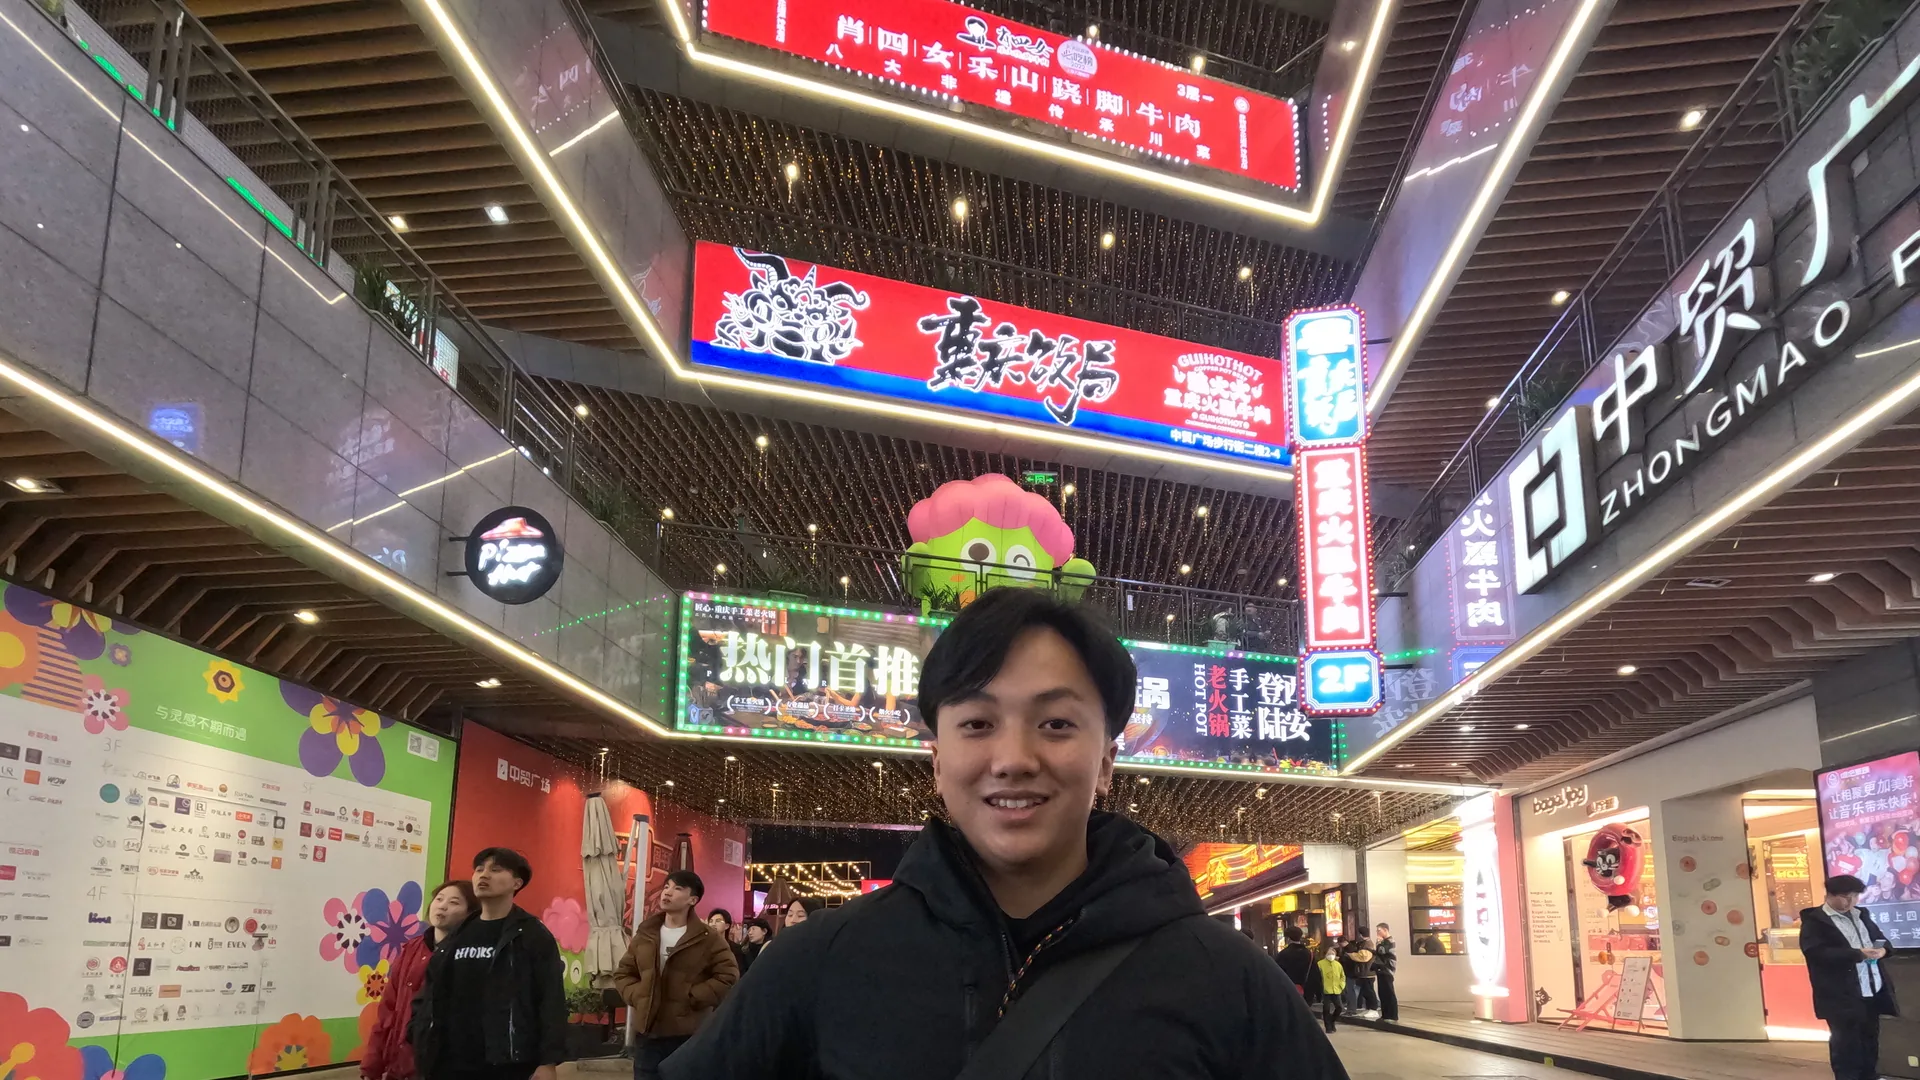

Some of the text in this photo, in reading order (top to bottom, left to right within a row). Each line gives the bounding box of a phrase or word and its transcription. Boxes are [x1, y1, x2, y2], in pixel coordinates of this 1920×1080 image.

[1178, 353, 1263, 381] GUIHOTHOT
[1601, 300, 1851, 527] ZHONGMAO
[719, 631, 919, 696] 热门首推
[1317, 664, 1370, 693] 2F
[1207, 665, 1230, 738] 老火锅
[1229, 667, 1253, 739] 手工菜
[155, 705, 247, 742] 与灵感不期而遇
[103, 738, 123, 752] 3F
[509, 765, 551, 794] 中贸广场
[87, 886, 108, 900] 4F
